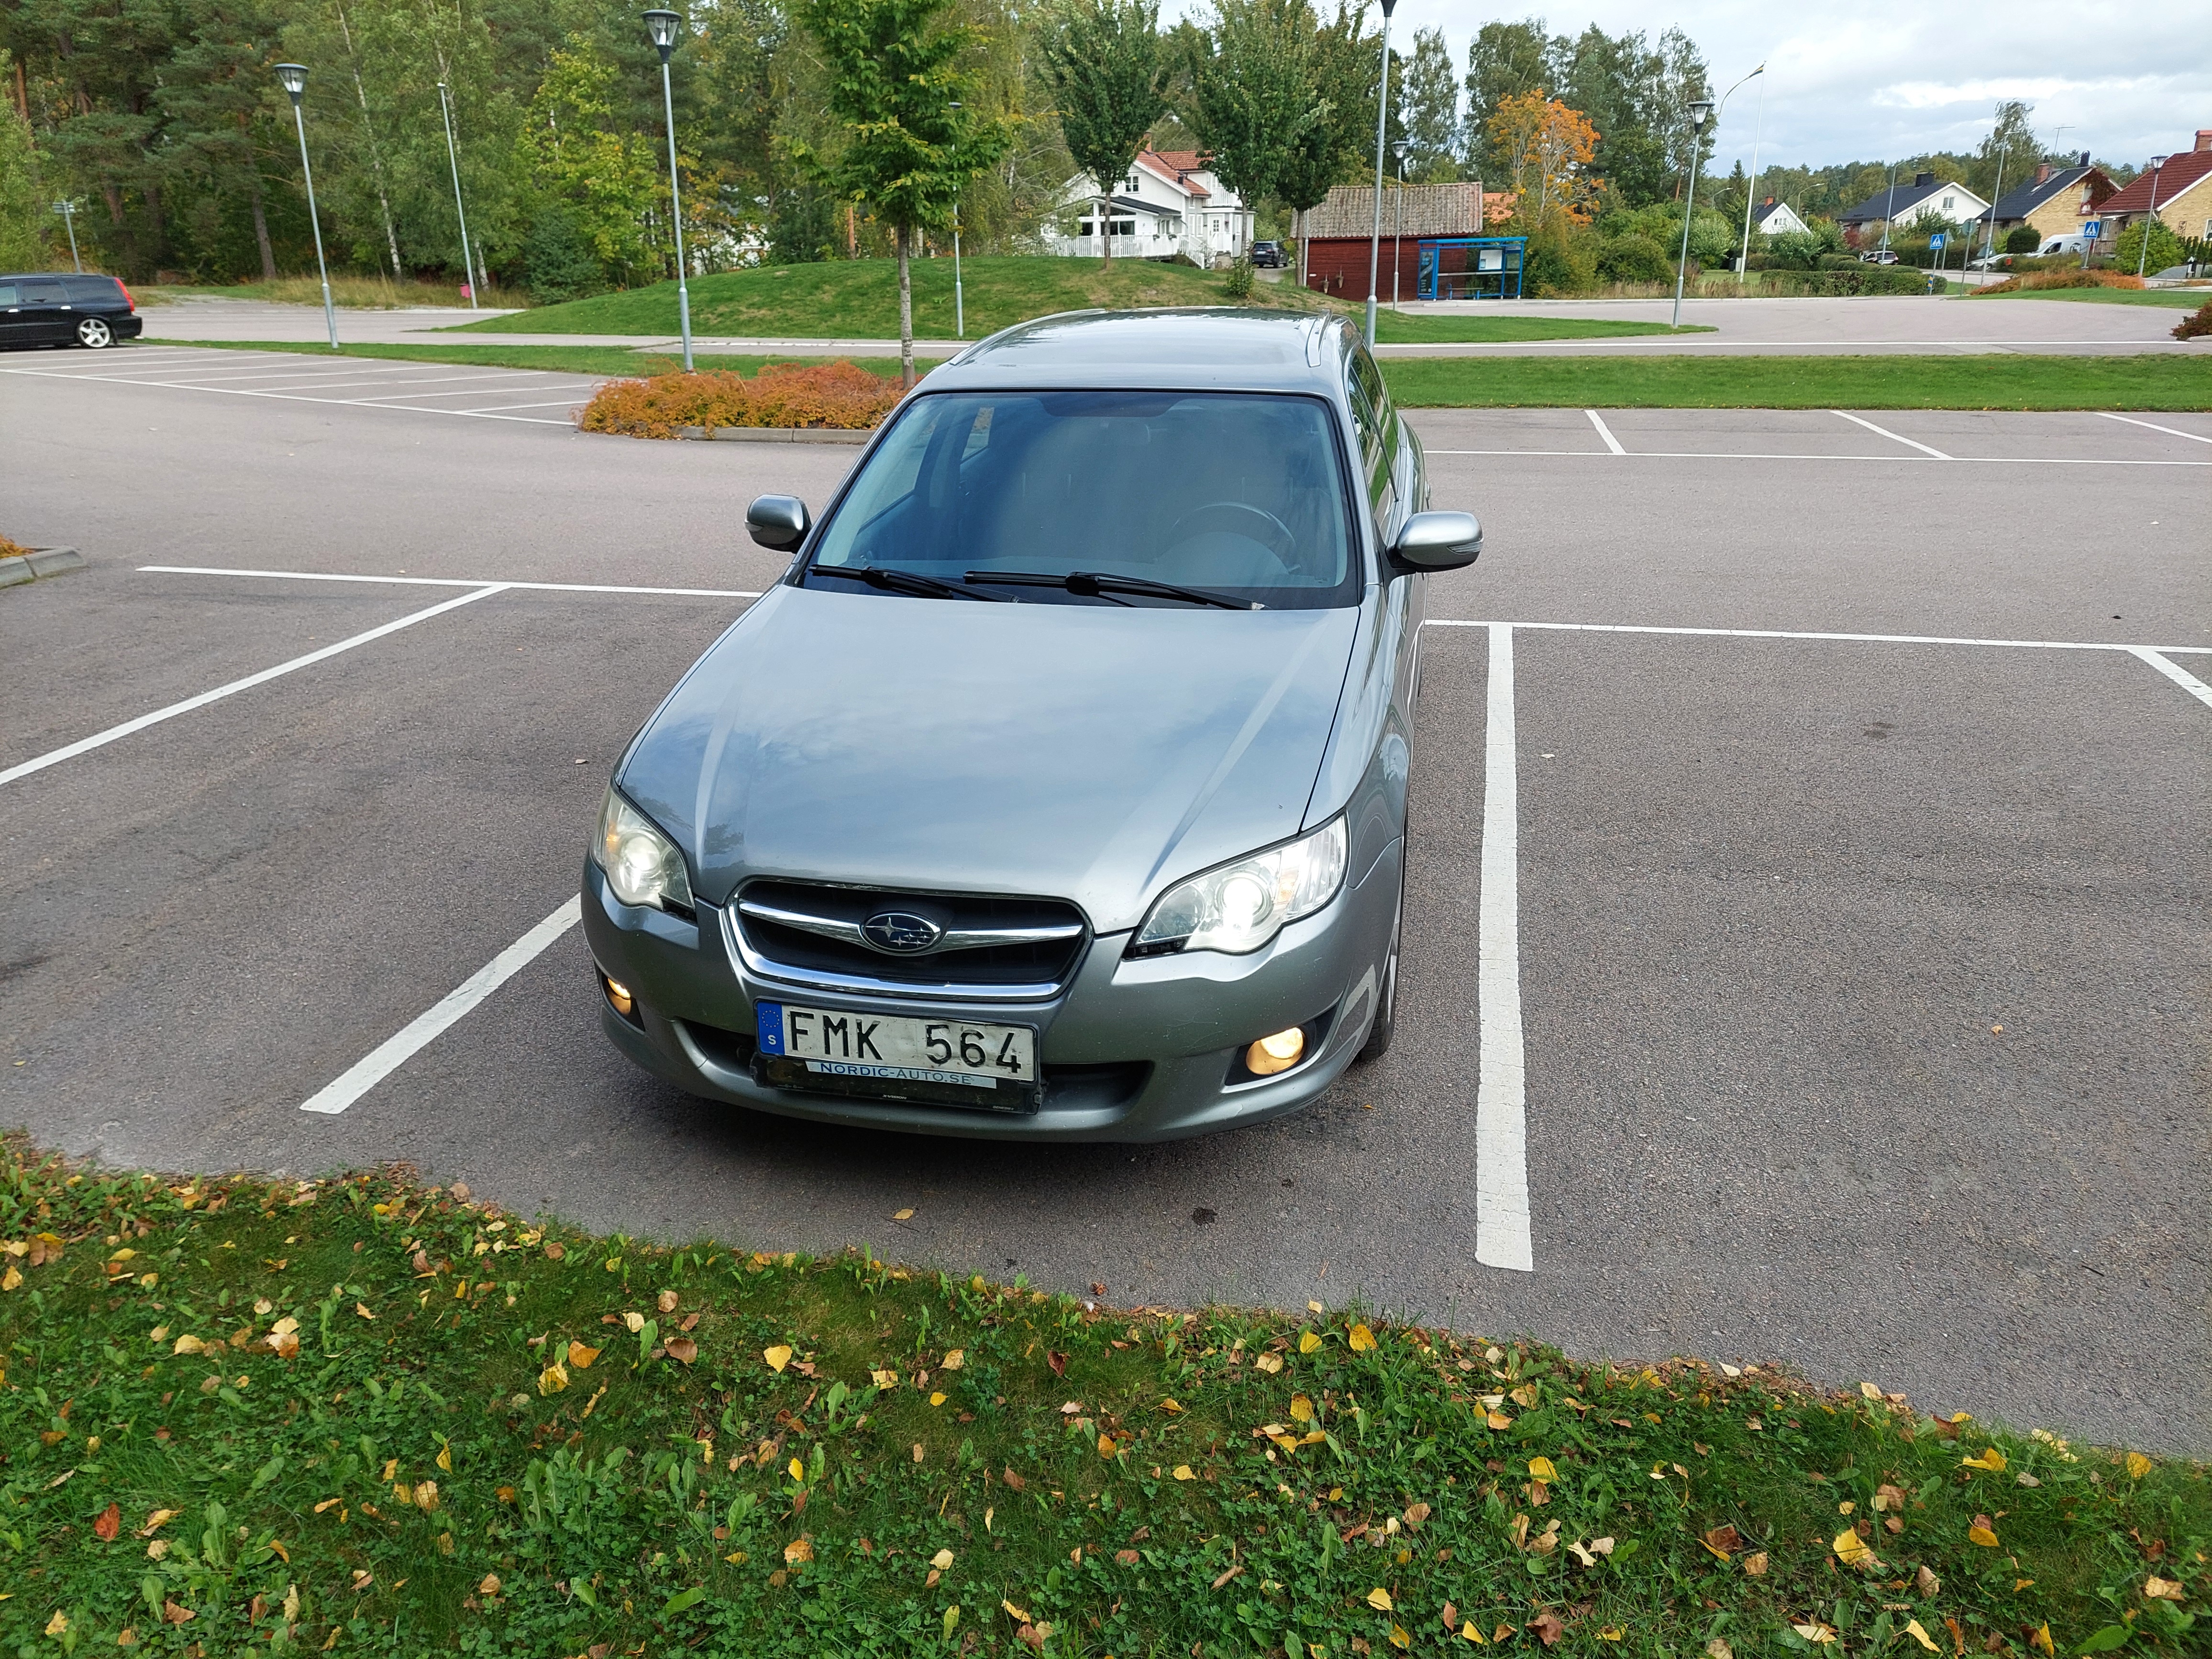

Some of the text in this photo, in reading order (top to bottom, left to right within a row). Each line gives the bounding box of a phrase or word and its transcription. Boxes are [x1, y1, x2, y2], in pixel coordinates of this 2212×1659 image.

[768, 1035, 776, 1045] S
[789, 1011, 1021, 1073] FMK 564
[820, 1063, 972, 1085] NORDIC-AUTO.SE
